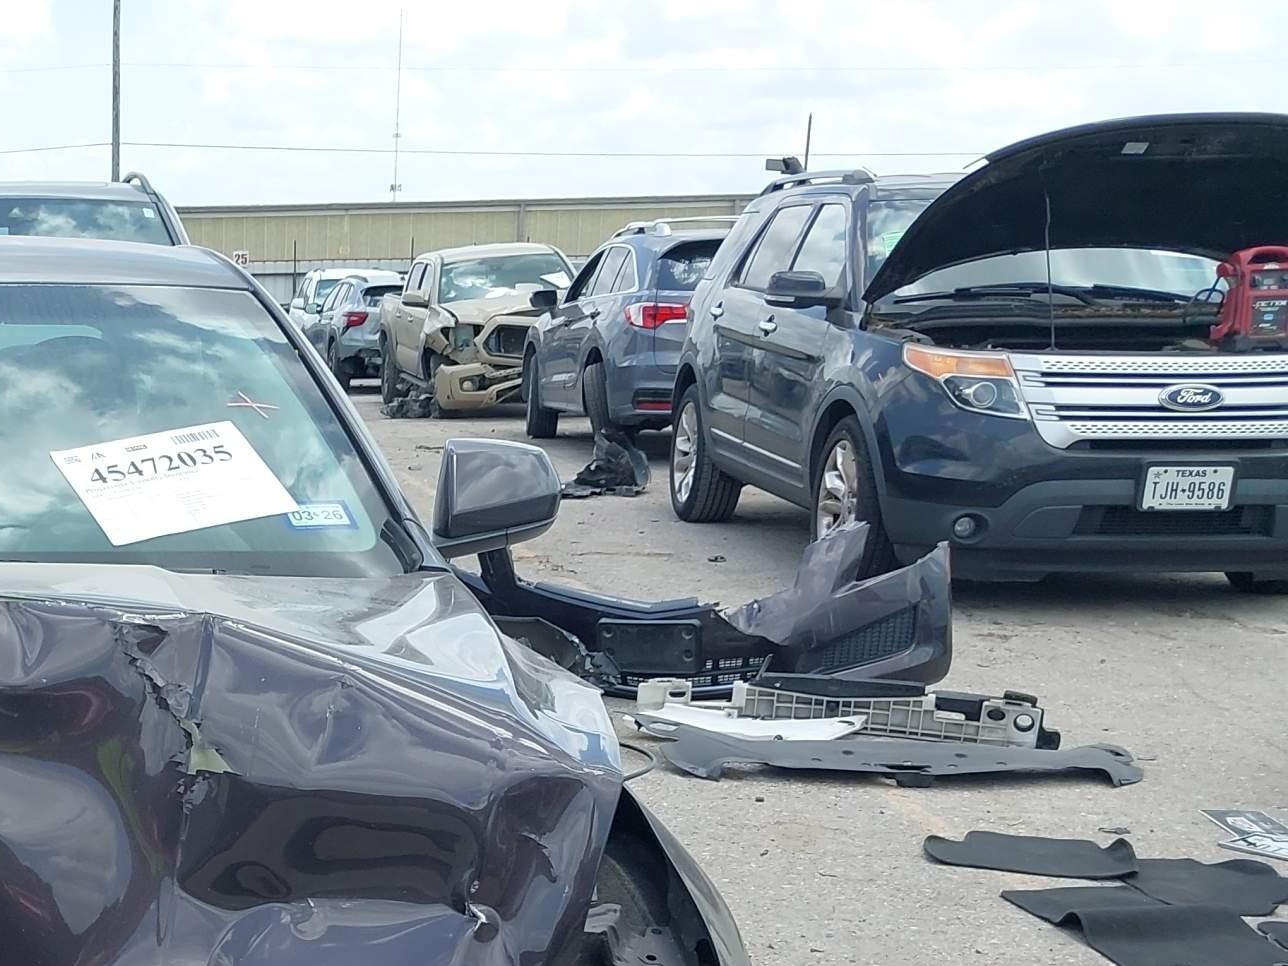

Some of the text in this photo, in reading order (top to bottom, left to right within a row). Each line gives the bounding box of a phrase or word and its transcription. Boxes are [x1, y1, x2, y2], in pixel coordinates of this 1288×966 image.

[234, 253, 248, 265] 25
[1176, 388, 1211, 404] Ford
[90, 445, 233, 484] 45472035
[1176, 469, 1208, 478] TEXAS
